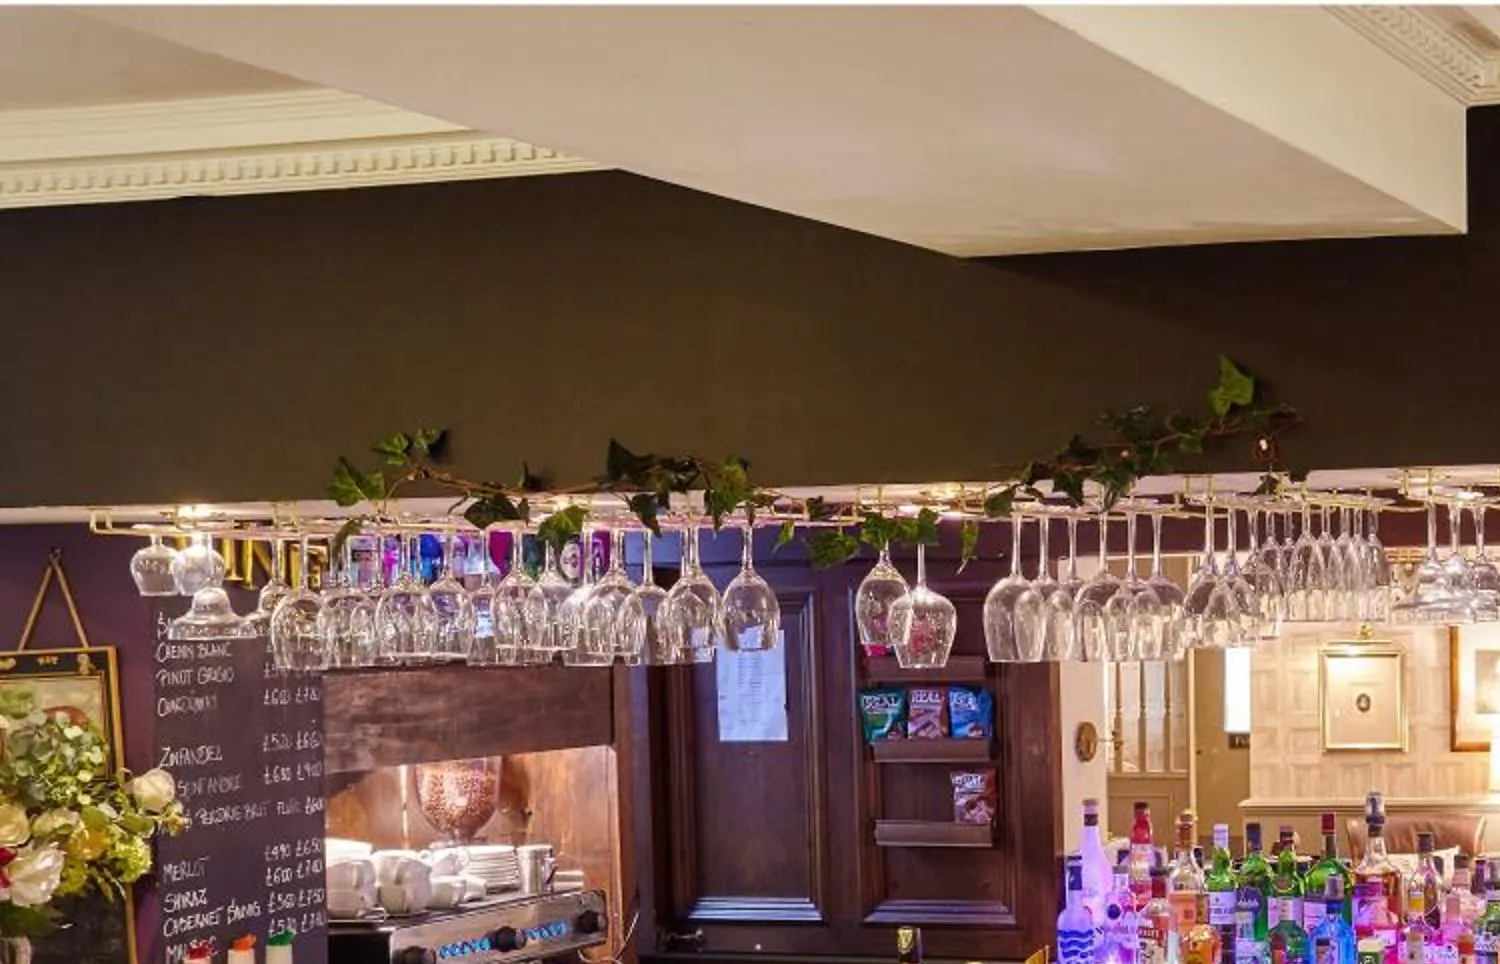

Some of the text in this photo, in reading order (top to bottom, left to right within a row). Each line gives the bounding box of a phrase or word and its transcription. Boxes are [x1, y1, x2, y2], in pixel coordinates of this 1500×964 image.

[155, 668, 194, 688] PINOT
[163, 855, 211, 885] MERLOT
[163, 888, 208, 913] SHIRAZ
